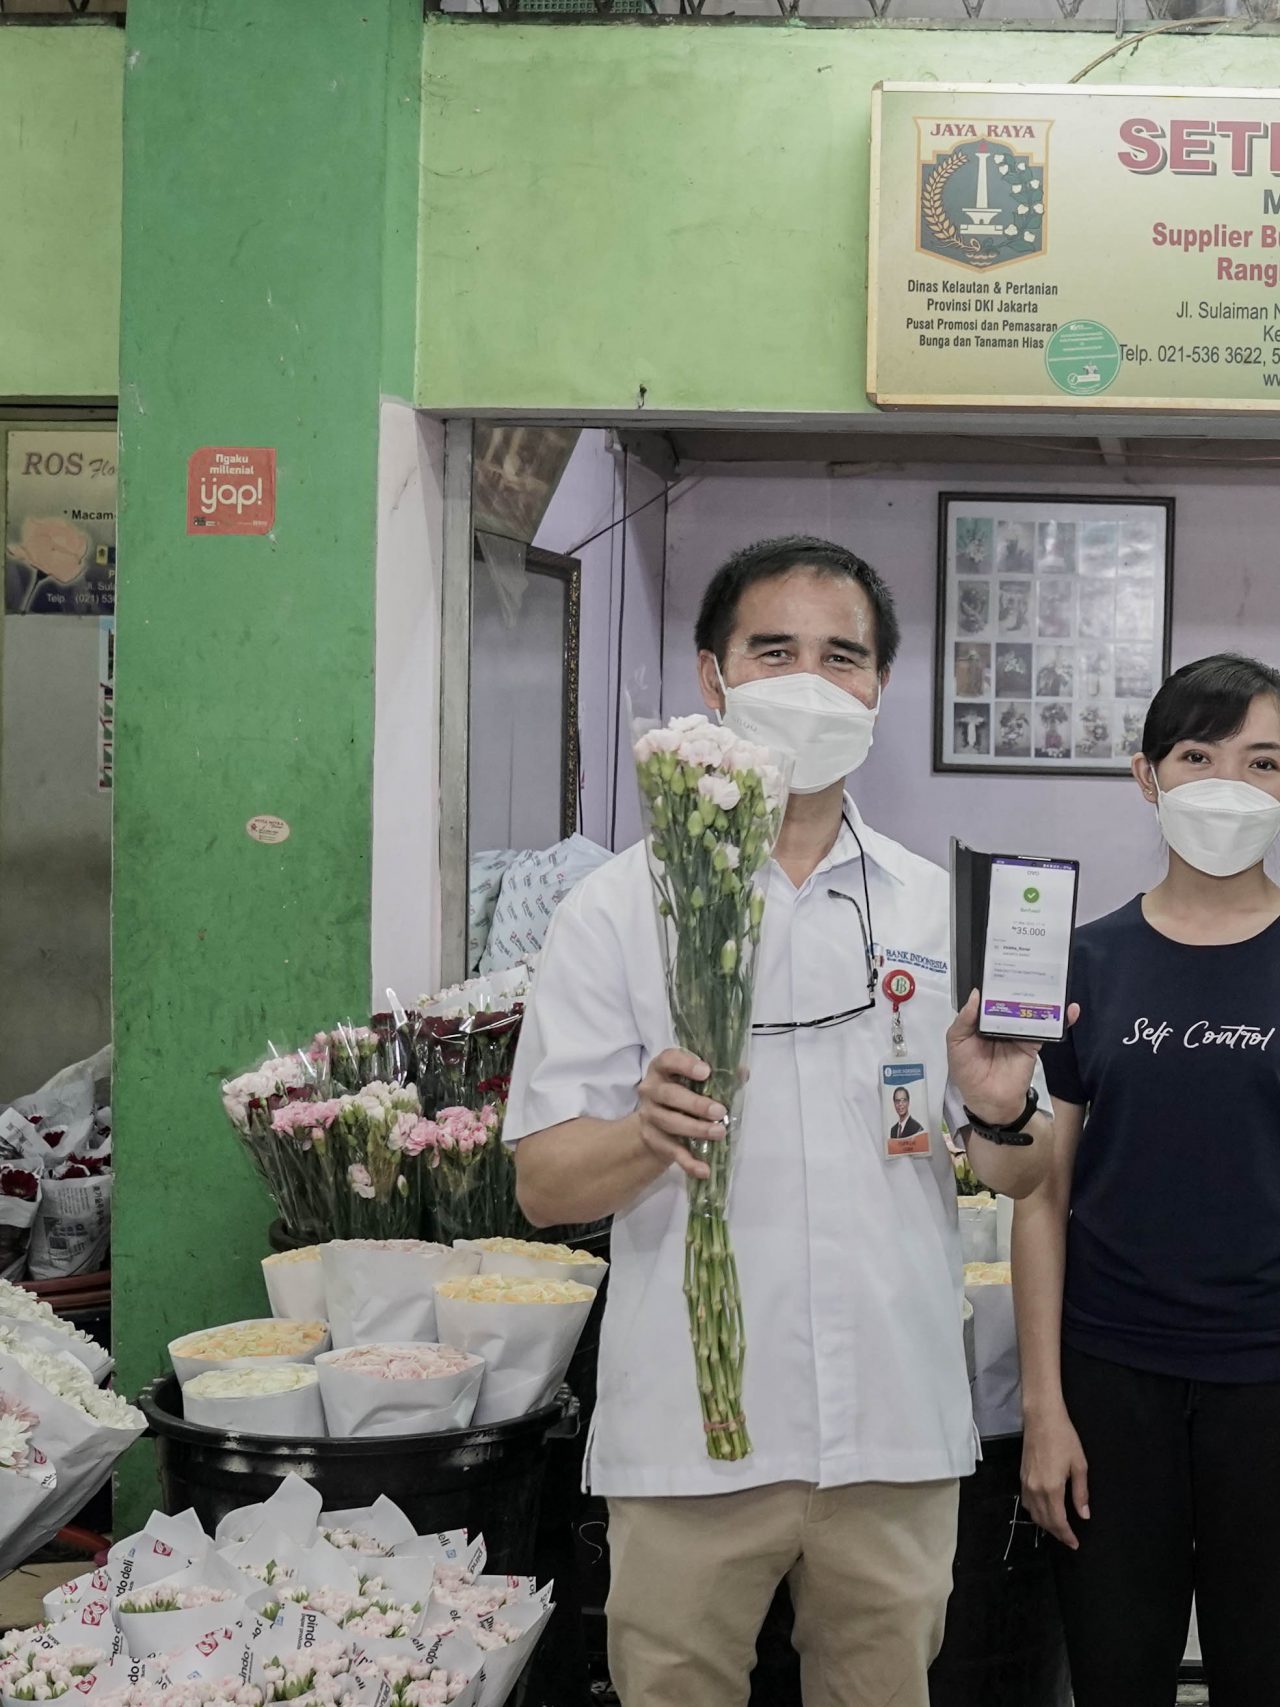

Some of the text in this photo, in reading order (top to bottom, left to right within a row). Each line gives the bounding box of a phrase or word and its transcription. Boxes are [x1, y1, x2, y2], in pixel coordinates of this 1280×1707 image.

[930, 123, 1036, 139] JAYA RAYA
[1152, 222, 1253, 252] Supplier
[907, 279, 1058, 296] Dinas Kelautan & Pertanian
[927, 298, 1038, 313] Provinsi DKI Jakarta
[1176, 301, 1192, 319] Jl.
[1198, 301, 1268, 321] Sulaiman
[906, 317, 934, 330] Pusat
[937, 318, 978, 331] Promosi
[981, 319, 999, 331] dan
[1002, 320, 1058, 333] Pemasaran
[919, 335, 950, 349] Bunga
[953, 335, 971, 348] dan
[974, 335, 1019, 349] Tanaman
[1022, 337, 1044, 349] Hias
[1119, 344, 1152, 366] Telp.
[1157, 345, 1220, 363] 021-536
[1224, 347, 1266, 367] 3622,
[22, 452, 83, 475] ROS
[209, 465, 254, 475] millenial
[885, 949, 909, 960] BANK
[909, 952, 948, 970] INDONESIA
[1122, 1017, 1276, 1054] Self Control
[122, 1558, 134, 1580] deli
[304, 1614, 316, 1648] pindo
